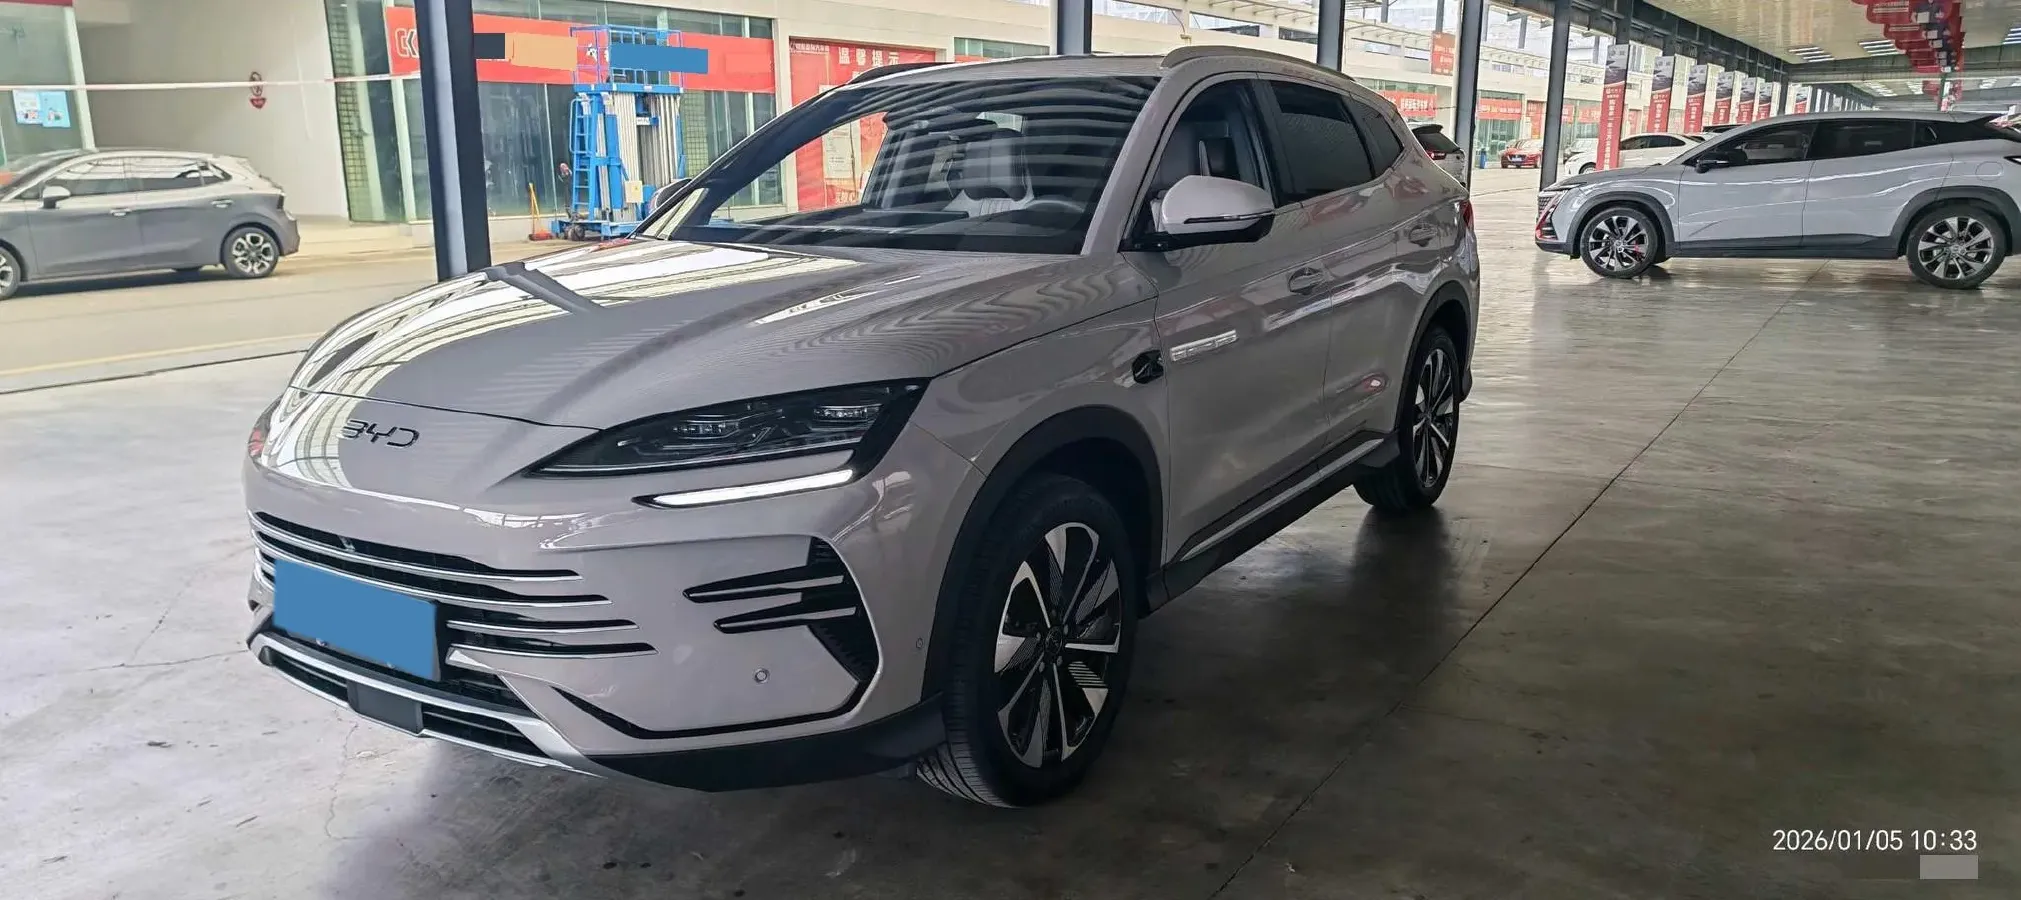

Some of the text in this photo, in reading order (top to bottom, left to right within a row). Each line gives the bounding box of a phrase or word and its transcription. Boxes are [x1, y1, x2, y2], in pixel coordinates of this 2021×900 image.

[839, 46, 900, 67] 温馨提示
[341, 418, 421, 448] BYD
